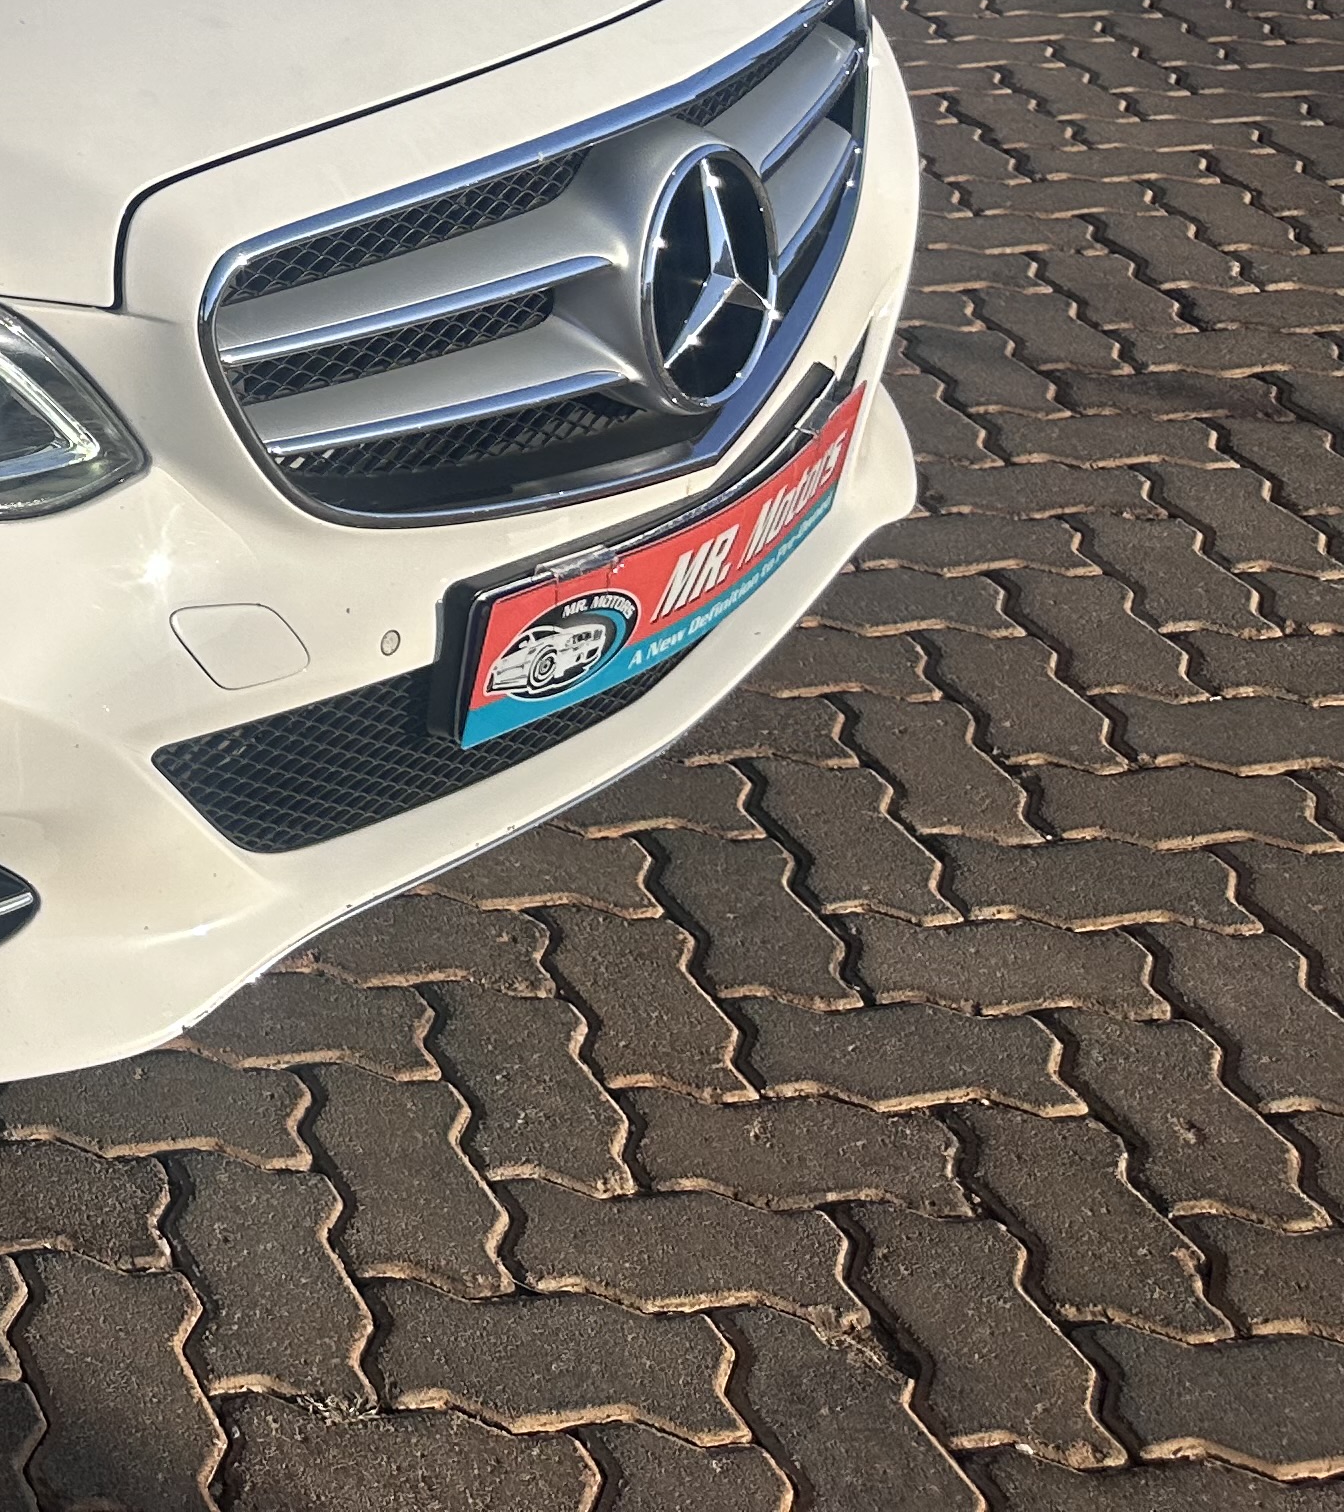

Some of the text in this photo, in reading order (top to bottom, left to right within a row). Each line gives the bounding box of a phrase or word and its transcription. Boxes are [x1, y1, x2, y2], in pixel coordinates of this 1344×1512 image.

[650, 428, 848, 624] MR. Motors
[562, 594, 636, 619] MR. MOTORS
[628, 650, 642, 670] A
[647, 630, 685, 660] New
[689, 570, 759, 635] Definition
